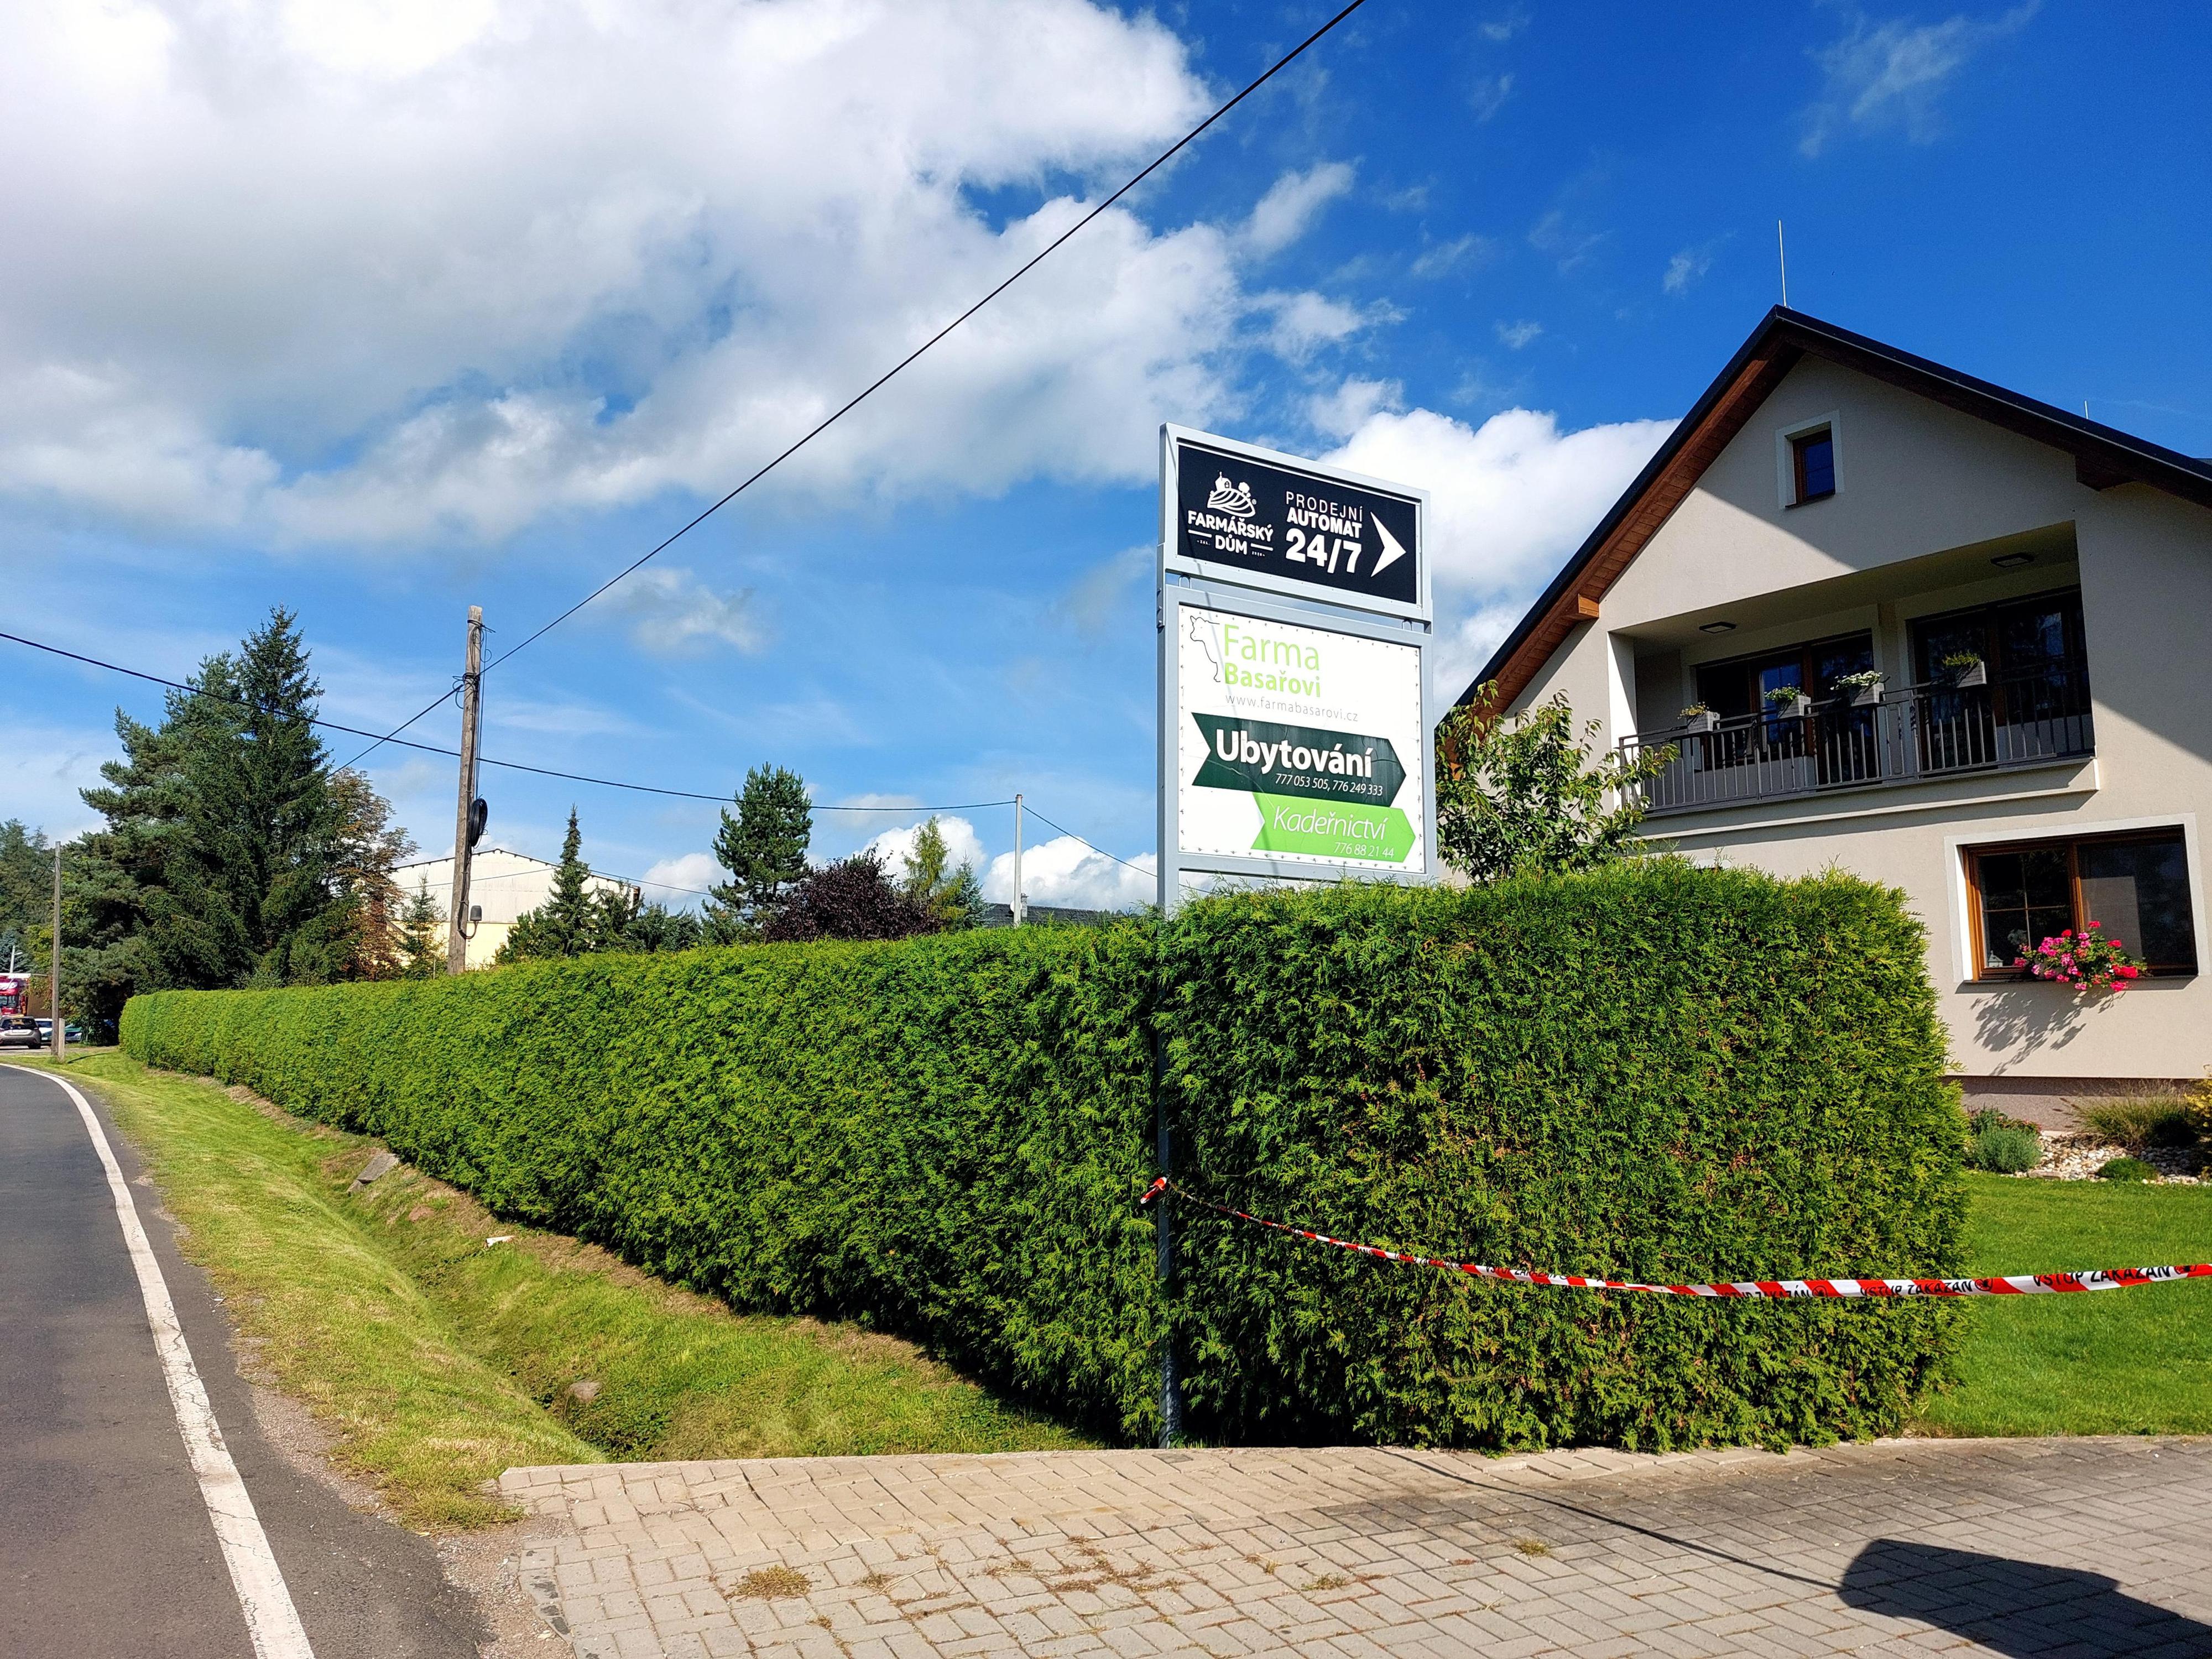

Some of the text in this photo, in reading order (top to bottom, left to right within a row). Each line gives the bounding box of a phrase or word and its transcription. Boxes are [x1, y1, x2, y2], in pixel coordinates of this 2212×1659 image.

[1286, 491, 1363, 522] PRODEJNÍ
[1188, 510, 1274, 542] FARMÁŘSKÝ
[1286, 507, 1362, 538] AUTOMAT
[1215, 534, 1247, 555] DŮM
[1286, 528, 1361, 573] 24/7
[1224, 624, 1319, 671] Farma
[1225, 662, 1321, 698] Basařovi
[1225, 695, 1358, 722] www.farmabasarovi.cz
[1217, 729, 1374, 778] Ubytování
[1275, 773, 1383, 796] 777 053 505, 776 249 333
[1274, 806, 1389, 841] Kadeřnictví
[1334, 842, 1394, 858] 776 88 21 44
